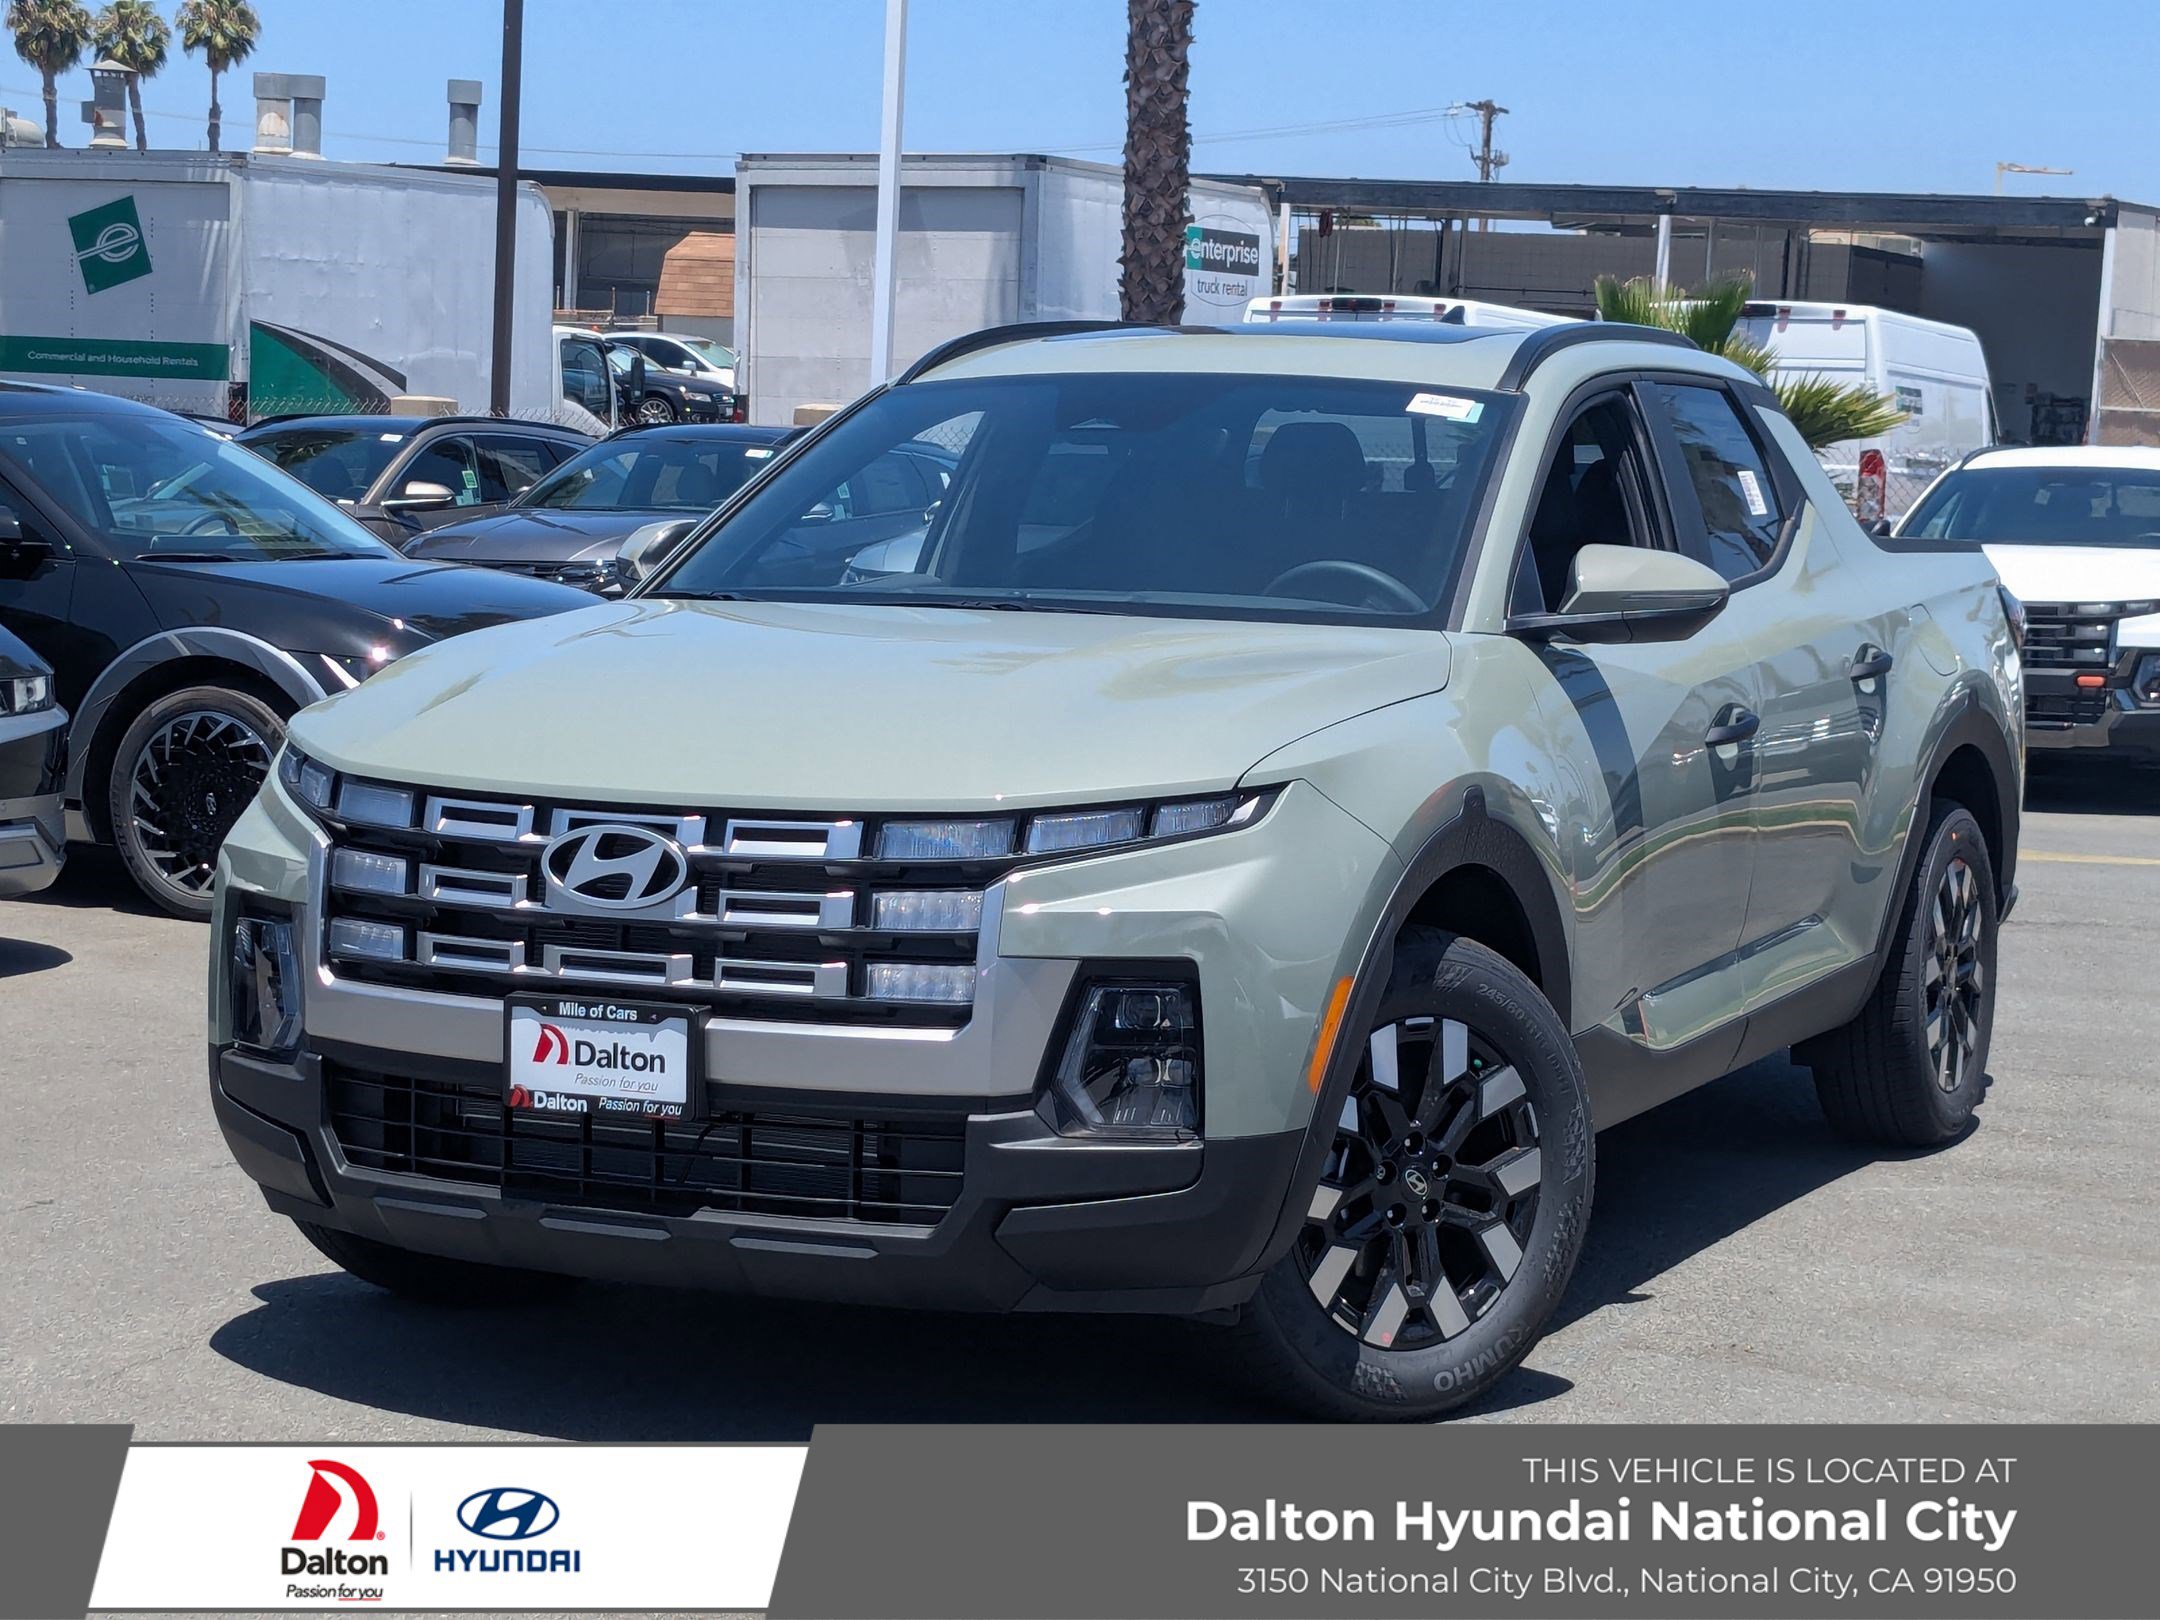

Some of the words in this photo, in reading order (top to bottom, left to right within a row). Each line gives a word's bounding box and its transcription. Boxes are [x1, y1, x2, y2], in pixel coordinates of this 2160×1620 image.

[1187, 237, 1259, 268] enterprise
[1197, 276, 1220, 295] truck
[1222, 279, 1248, 297] rental
[27, 350, 86, 362] Commercial
[87, 353, 106, 363] and
[107, 354, 161, 366] Household
[162, 356, 199, 367] Rentals
[559, 1002, 587, 1017] Mile
[589, 1004, 604, 1018] of
[606, 1006, 638, 1021] Cars
[574, 1040, 666, 1074] Dalton
[574, 1073, 620, 1088] Passion
[619, 1076, 636, 1090] for
[637, 1081, 659, 1092] you
[533, 1091, 588, 1113] Dalton
[599, 1097, 640, 1113] Passion
[642, 1100, 658, 1114] for
[660, 1104, 683, 1117] you
[1433, 1326, 1531, 1392] KUMHO
